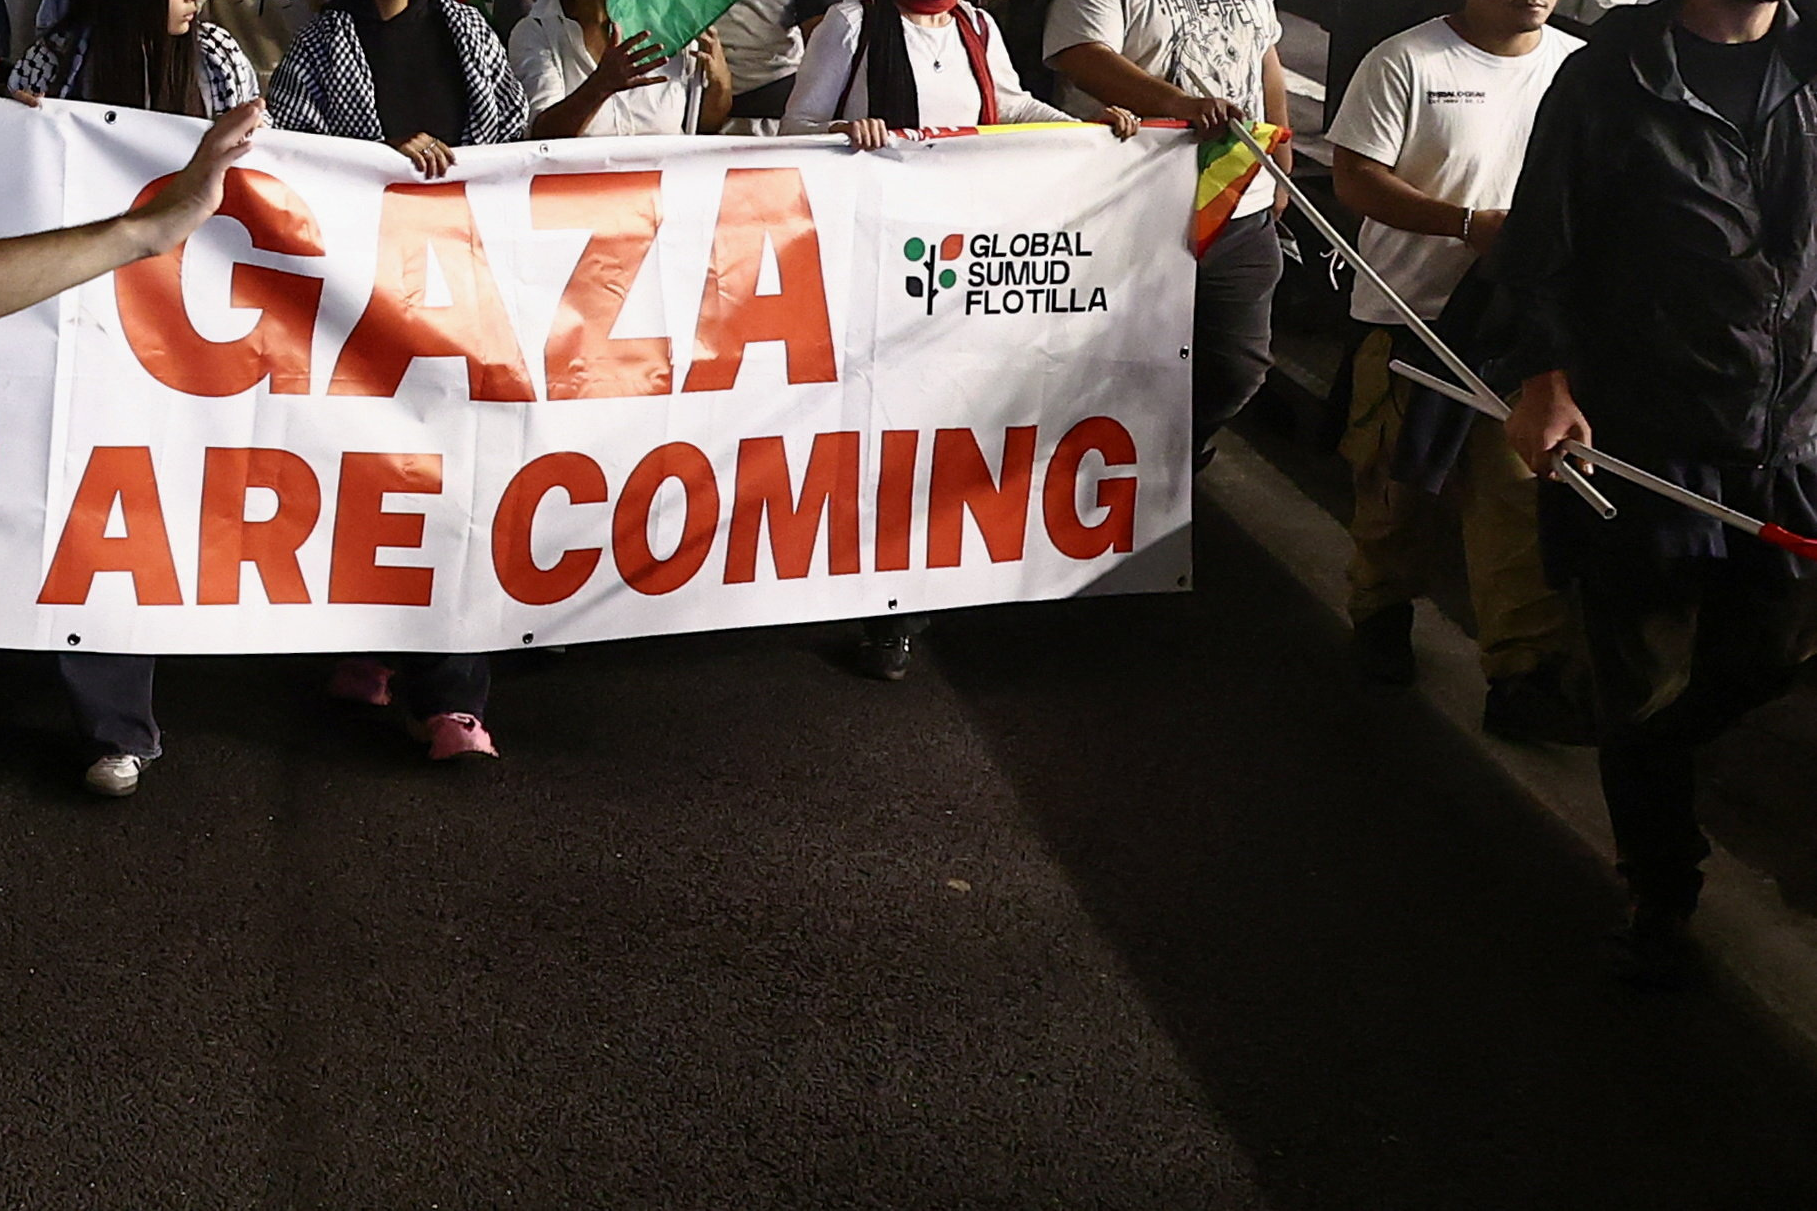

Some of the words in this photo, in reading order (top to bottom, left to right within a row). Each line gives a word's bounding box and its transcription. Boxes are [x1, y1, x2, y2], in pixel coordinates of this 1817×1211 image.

[970, 232, 1092, 258] GLOBAL
[112, 167, 839, 402] GAZA
[968, 260, 1070, 287] SUMUD
[965, 288, 1108, 316] FLOTILLA
[36, 446, 444, 605] ARE
[492, 416, 1139, 606] COMING
